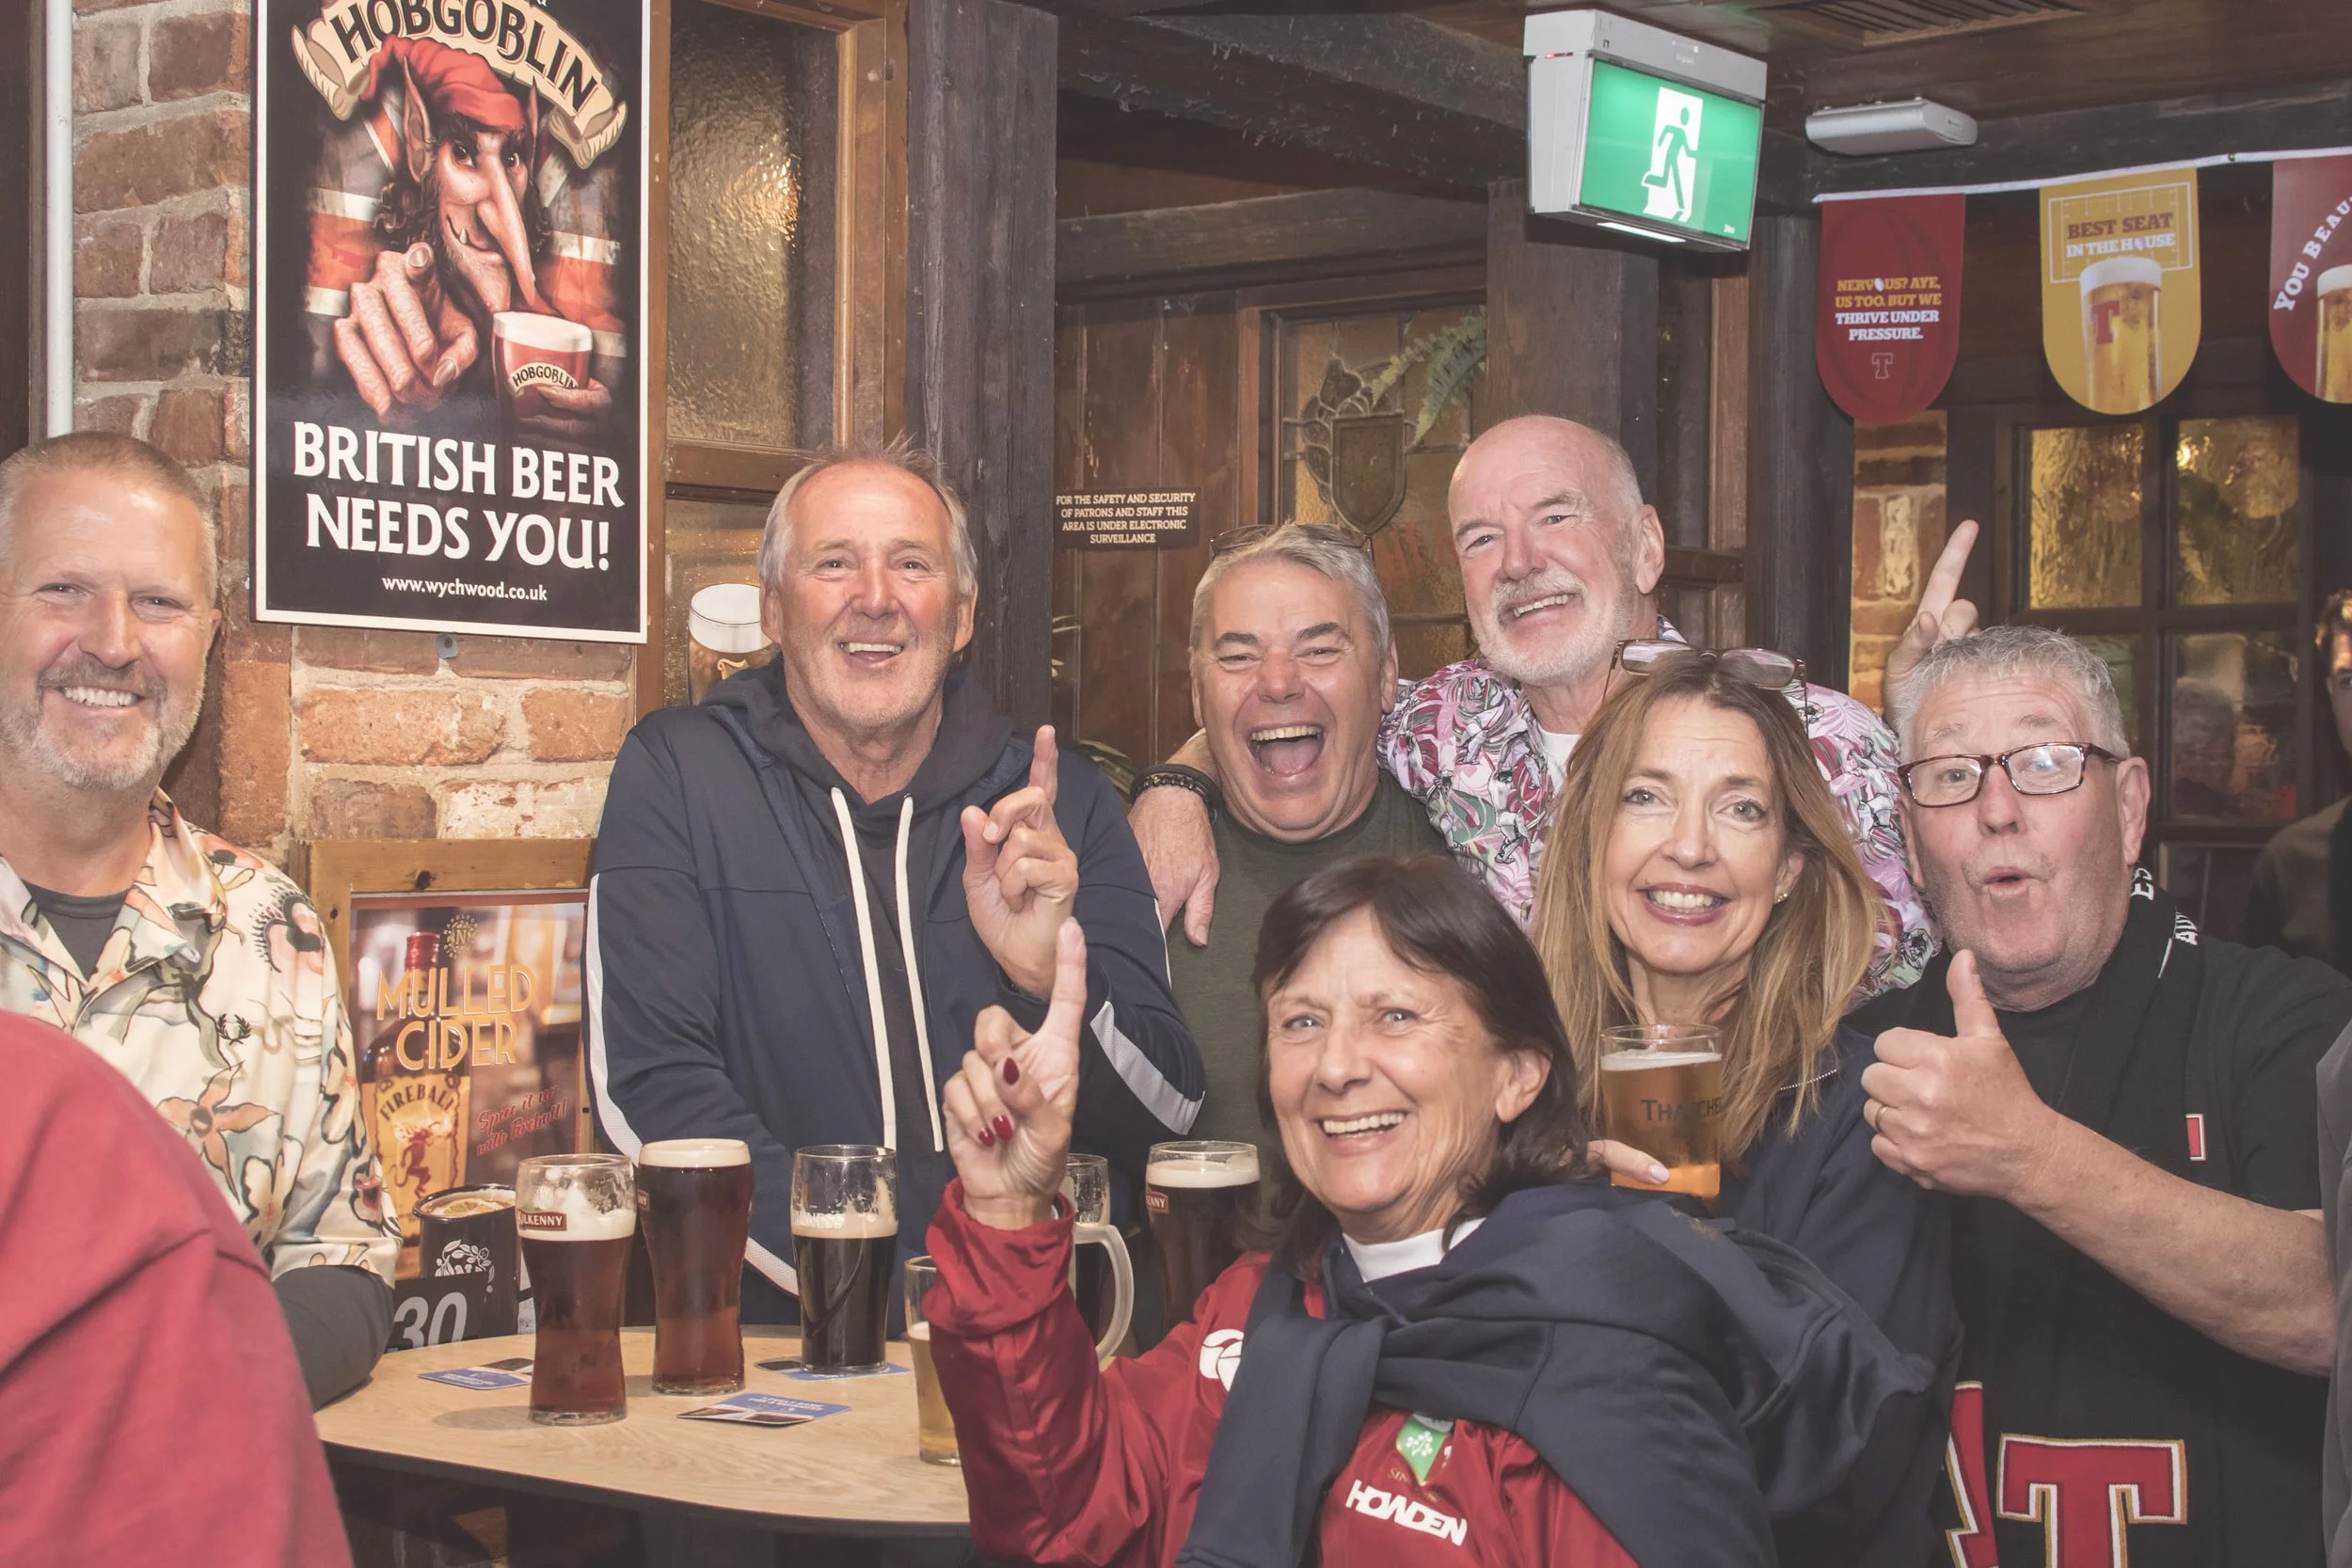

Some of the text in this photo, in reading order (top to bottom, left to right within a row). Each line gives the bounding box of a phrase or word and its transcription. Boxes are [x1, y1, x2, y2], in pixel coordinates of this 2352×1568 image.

[330, 0, 598, 113] HOBGOBLIN
[2067, 213, 2173, 240] BEST SEAT
[2066, 244, 2084, 258] IN
[2085, 240, 2119, 255] THE
[2273, 197, 2352, 311] YOU BEAU
[1835, 295, 1852, 308] US
[1887, 293, 1916, 307] BUT
[1918, 293, 1942, 306] WE
[1835, 309, 1940, 325] THRIVE UNDER
[1848, 326, 1924, 341] PRESSURE.
[294, 420, 626, 508] BRITISH BEER
[1056, 492, 1196, 505] FOR THE SAFETY AND SECURITY
[1061, 506, 1188, 518] OF PATRONS AND STAFF THIS
[1062, 519, 1186, 531] AREA IS UNDER ELECTRONIC
[306, 493, 610, 571] NEEDS YOU!
[1089, 533, 1156, 544] SURVEILLANCE
[382, 577, 548, 602] www.wychwood.co.uk
[376, 963, 538, 1021] MULLED
[396, 1017, 516, 1070] CIDER
[478, 1085, 559, 1133] Spice it up
[476, 1131, 507, 1157] with
[393, 1291, 468, 1349] 30
[1344, 1479, 1468, 1546] HOWDEN
